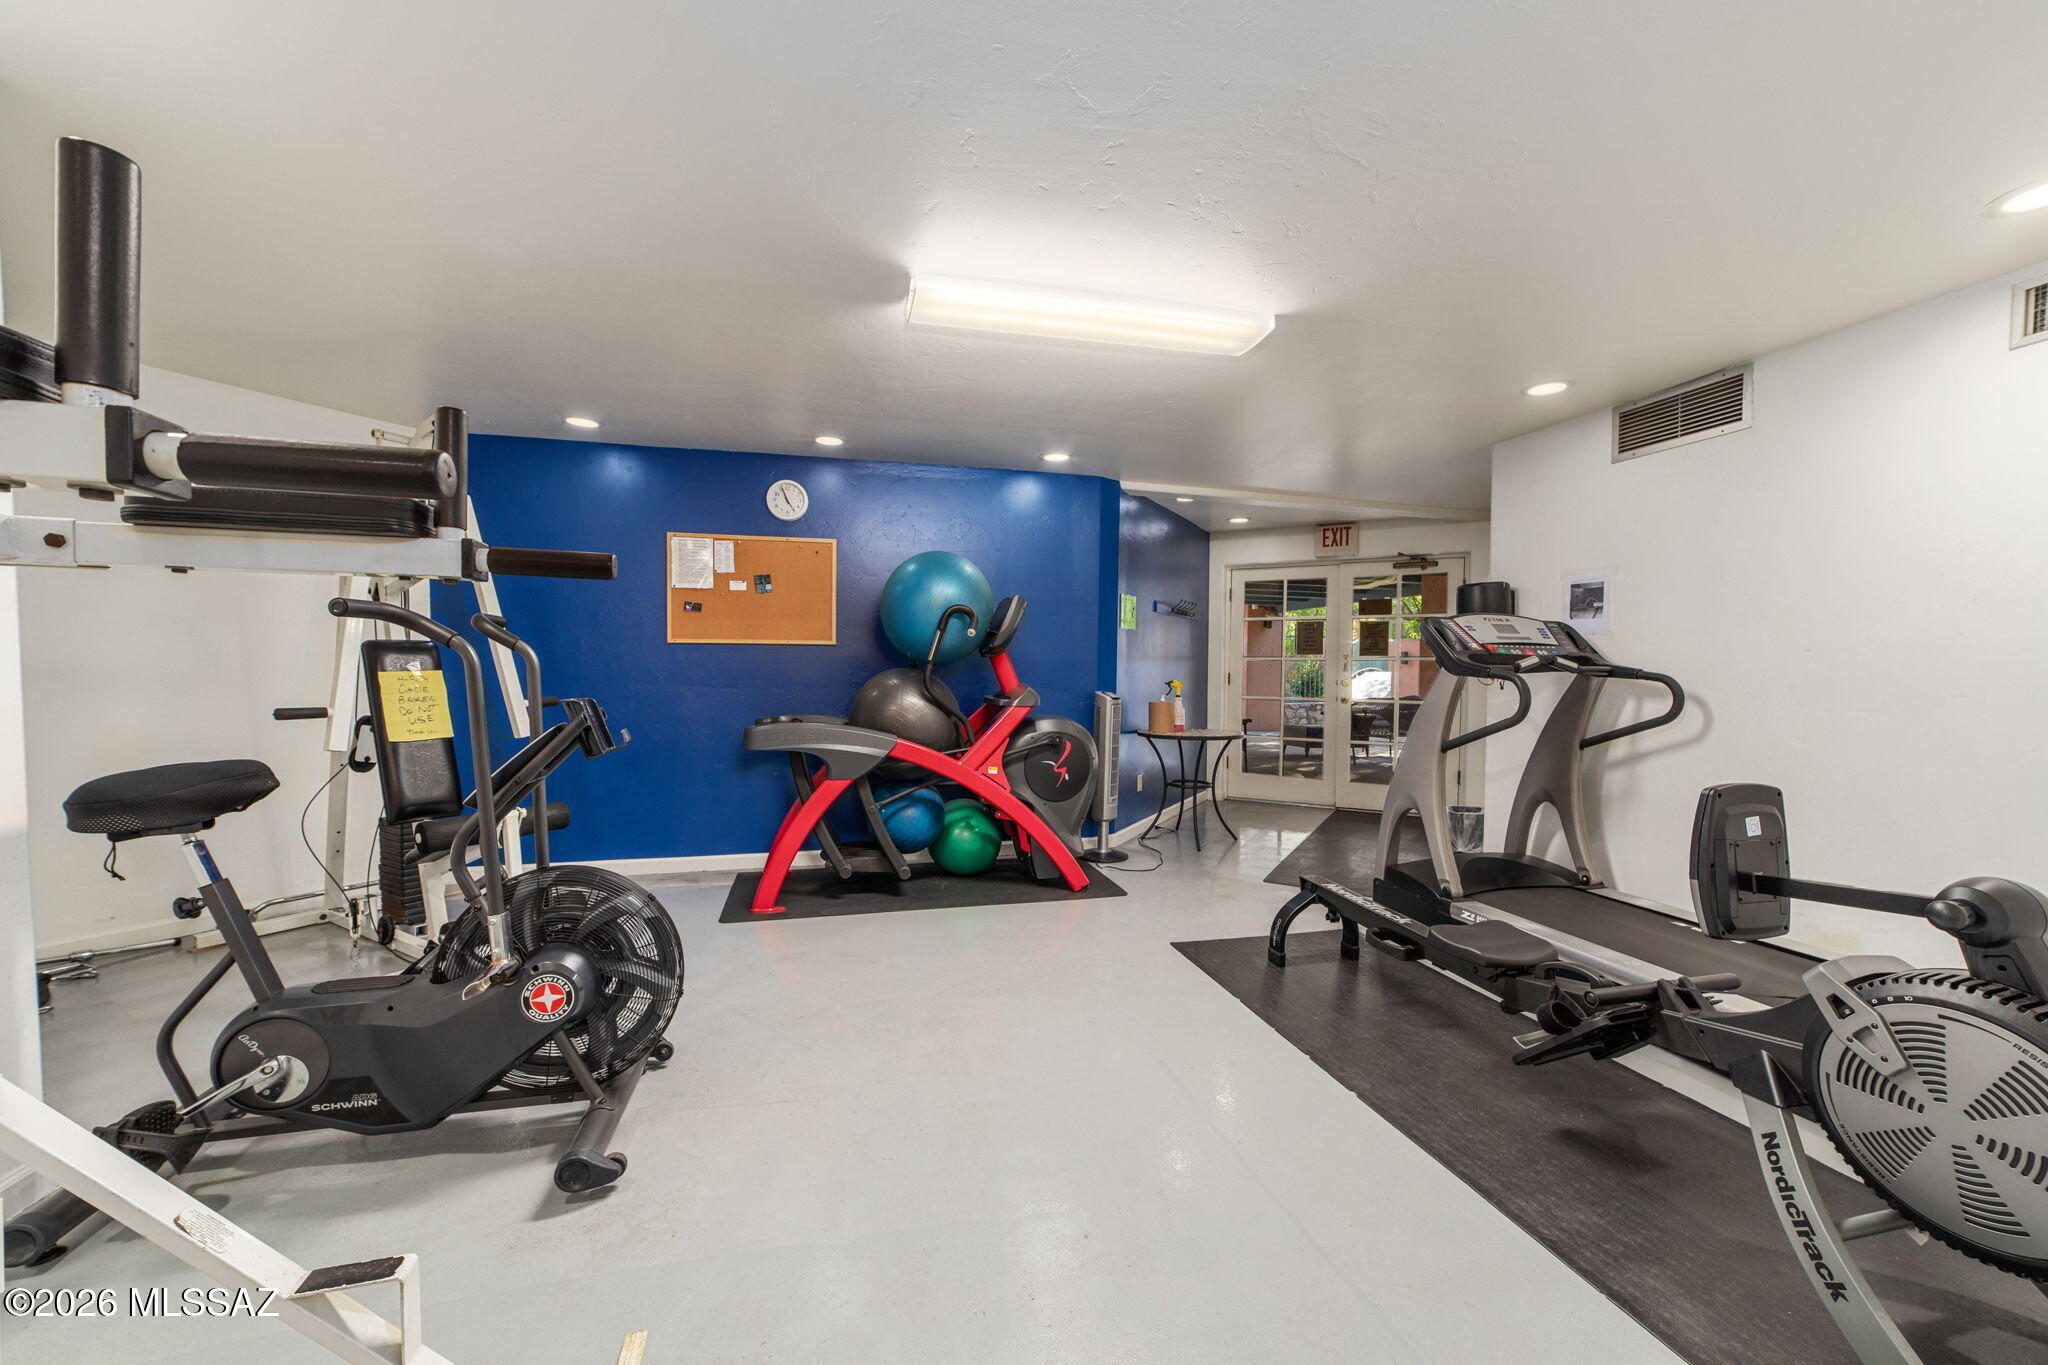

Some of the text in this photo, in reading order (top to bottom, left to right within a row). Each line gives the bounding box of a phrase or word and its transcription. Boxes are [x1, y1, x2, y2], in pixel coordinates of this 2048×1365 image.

[1322, 526, 1352, 547] EXIT
[409, 714, 434, 725] USE
[524, 976, 571, 997] SCHWINN
[528, 1004, 569, 1020] QUALITY
[311, 1099, 378, 1112] SCHWINN
[1761, 1131, 1850, 1303] NordicTrack
